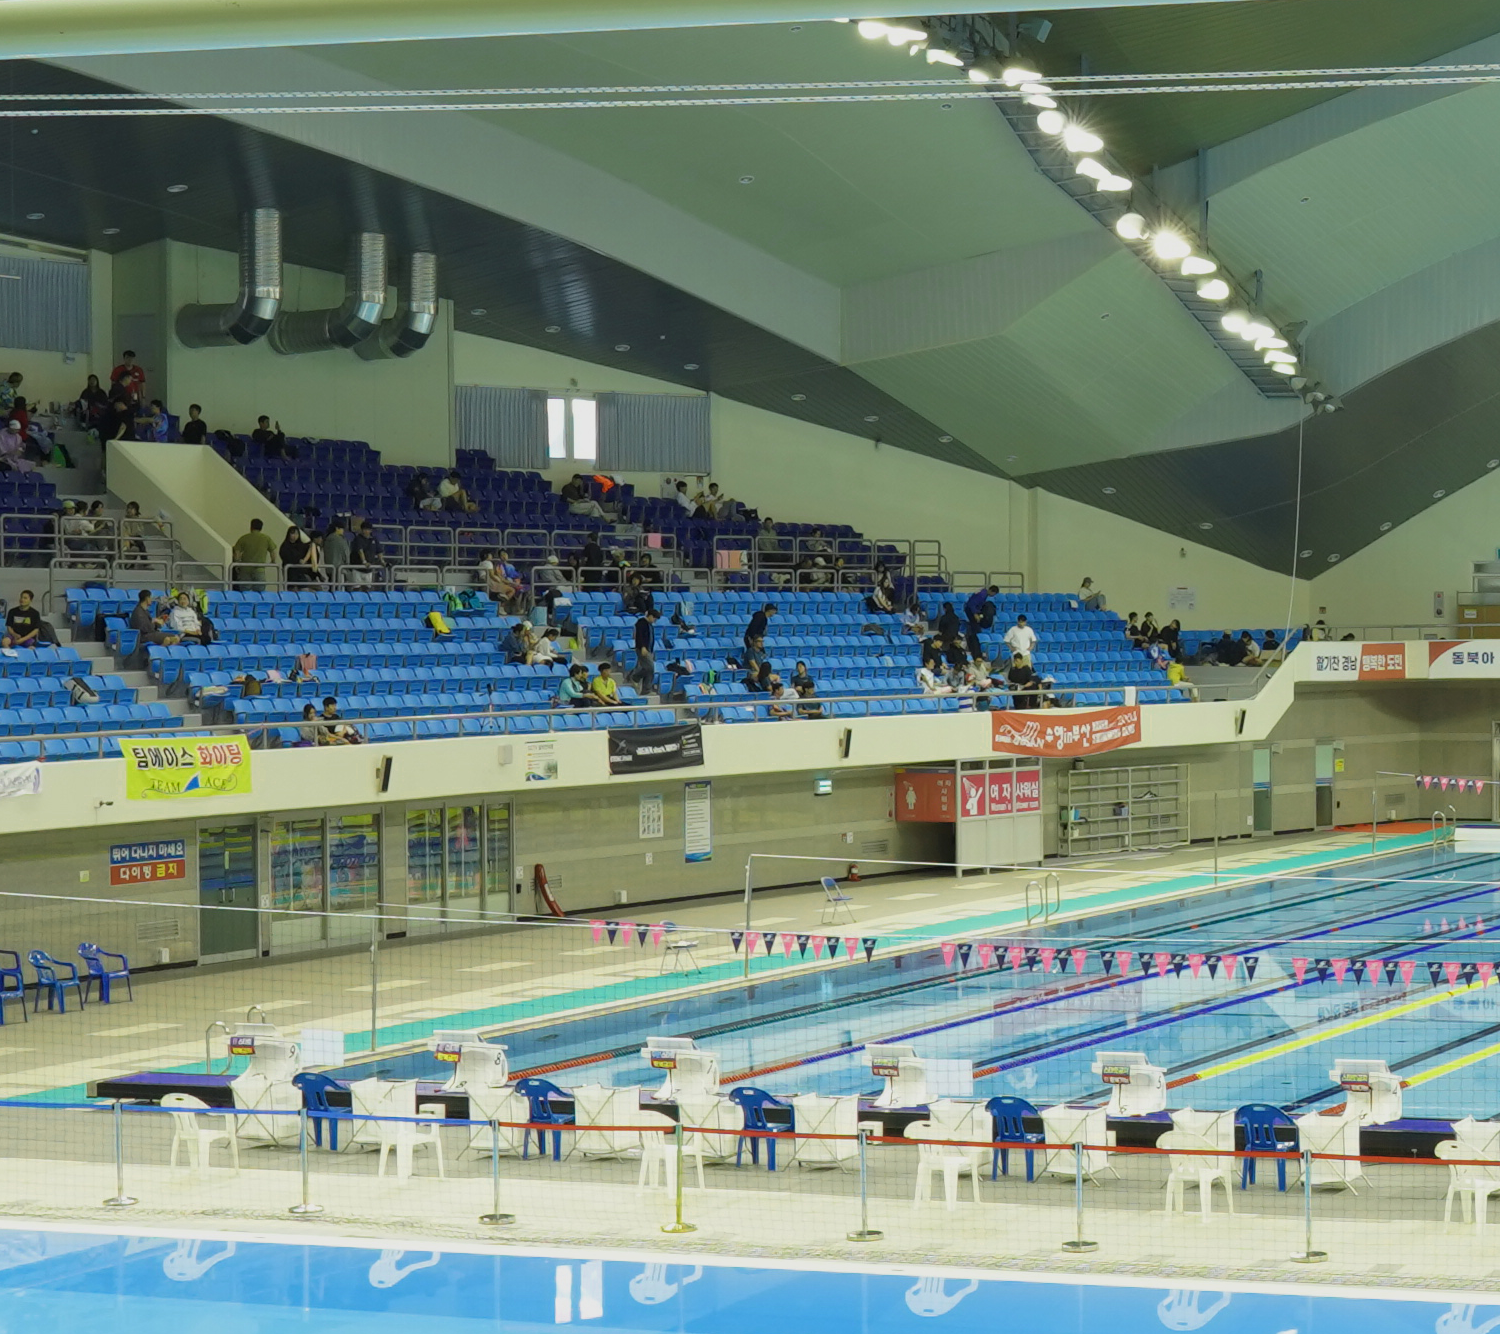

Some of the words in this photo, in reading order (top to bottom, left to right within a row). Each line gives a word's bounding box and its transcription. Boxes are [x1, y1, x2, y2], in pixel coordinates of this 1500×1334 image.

[1342, 655, 1358, 671] 경남
[1452, 651, 1495, 665] 동북아
[132, 747, 195, 770] 팀에이스
[199, 743, 243, 768] 화이팅
[150, 778, 182, 794] TEAM
[204, 777, 227, 791] ACE
[1015, 781, 1039, 798] 샤워실
[112, 847, 129, 861] 뛰어
[131, 845, 156, 859] 다니지
[158, 842, 184, 857] 마세요
[156, 863, 177, 877] 금지
